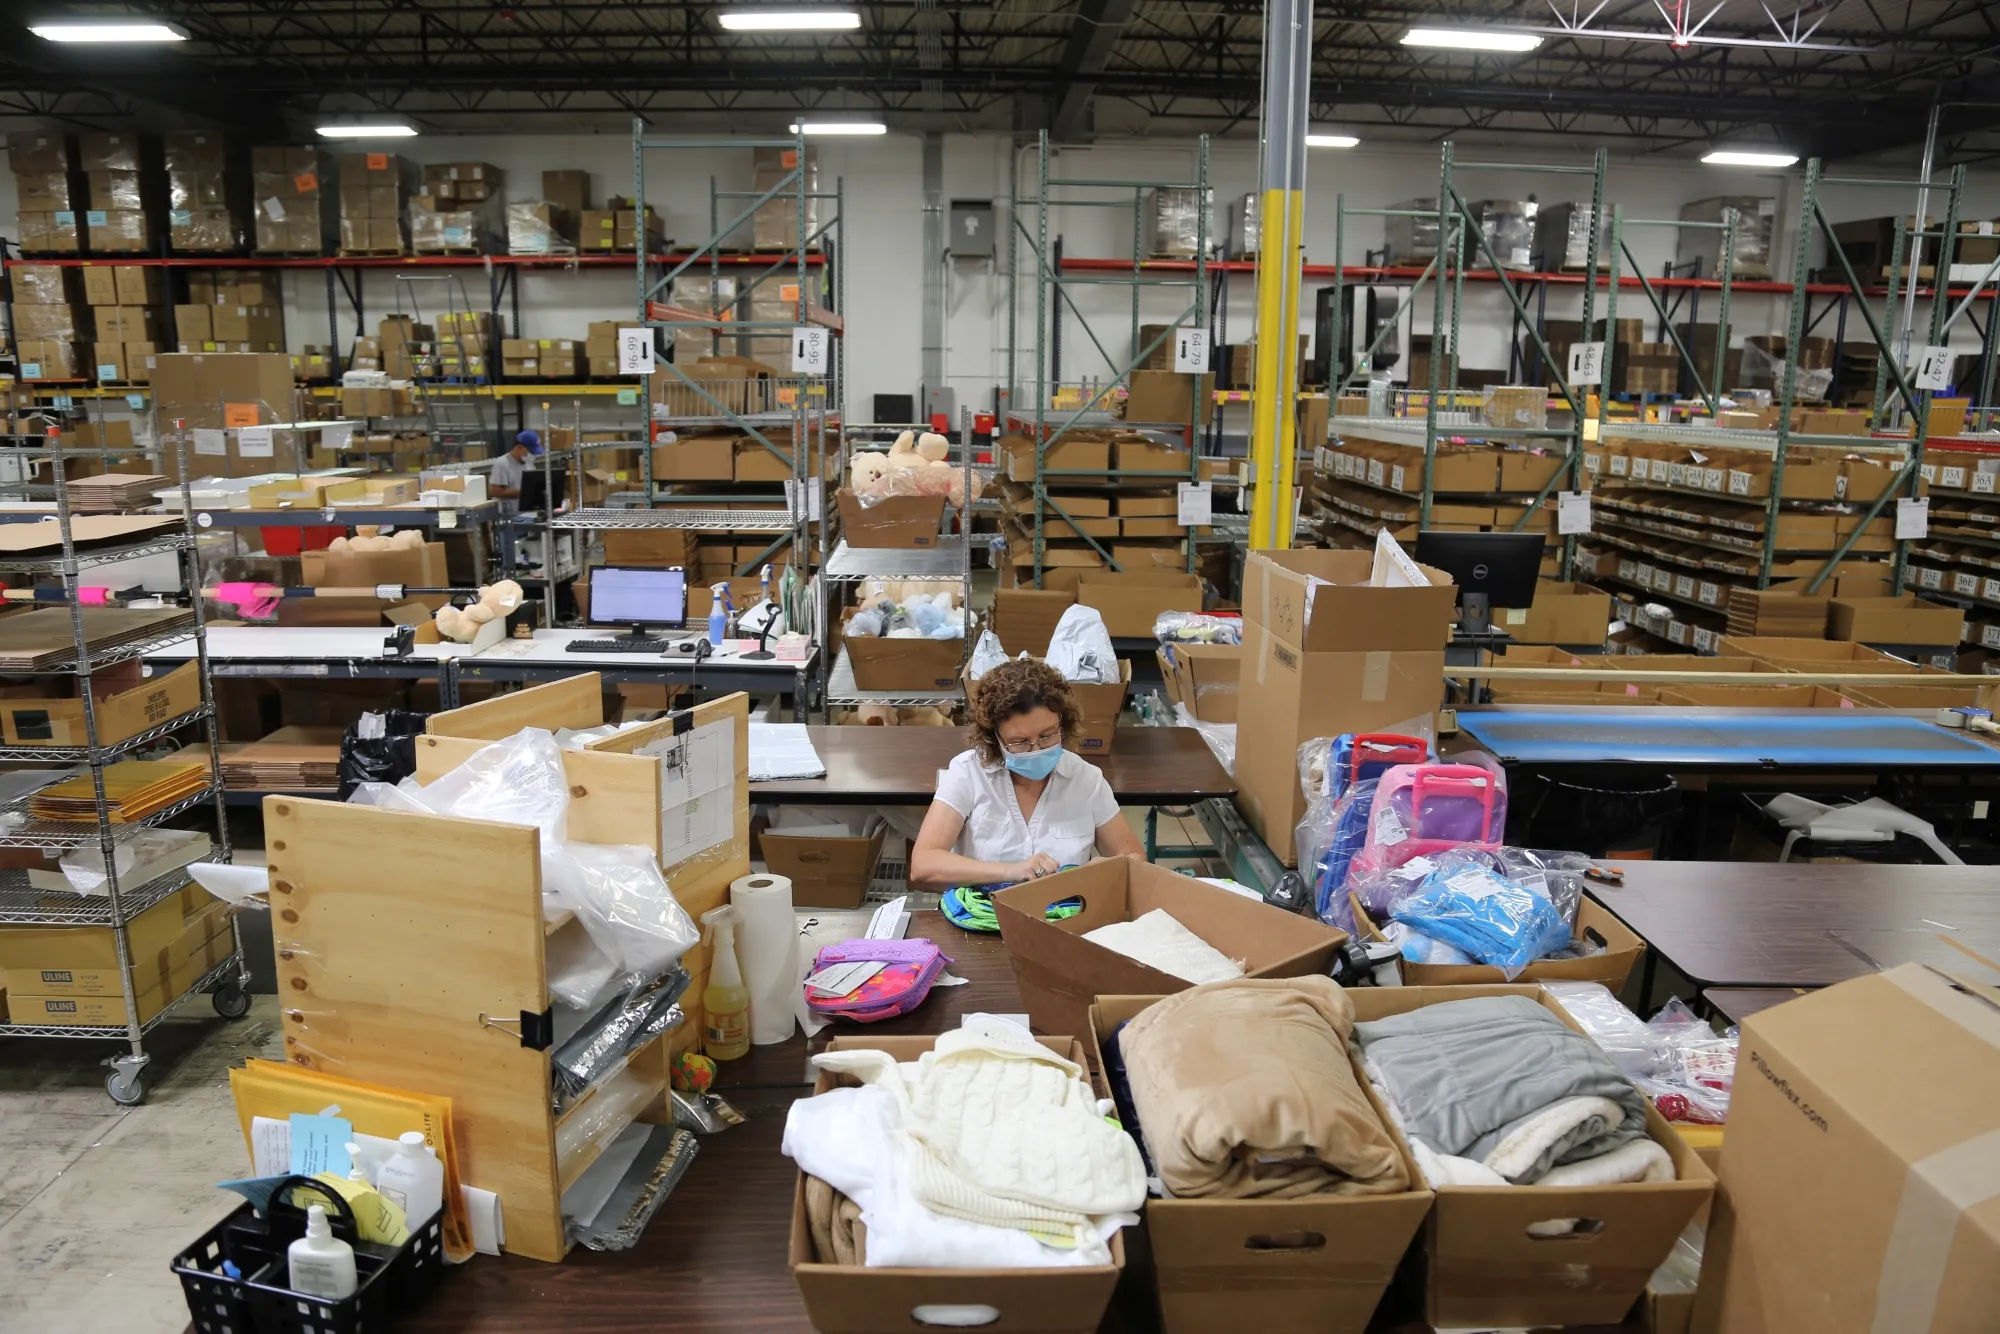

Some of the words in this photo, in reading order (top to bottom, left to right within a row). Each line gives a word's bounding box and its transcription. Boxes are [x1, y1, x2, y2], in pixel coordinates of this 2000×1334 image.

[627, 336, 639, 369] 96-99
[808, 332, 820, 365] 80-95
[1190, 333, 1202, 365] 64-79
[1583, 346, 1596, 376] 48-63
[1931, 352, 1948, 382] 32-47
[1732, 473, 1746, 486] 55A
[1944, 468, 1960, 480] 35A
[1974, 474, 1992, 485] 36A
[1836, 481, 1845, 494] C
[1959, 575, 1973, 587] 36E
[42, 972, 71, 982] ULINE
[46, 1002, 76, 1011] ULINE
[1751, 1050, 1828, 1133] Pillowflex.com
